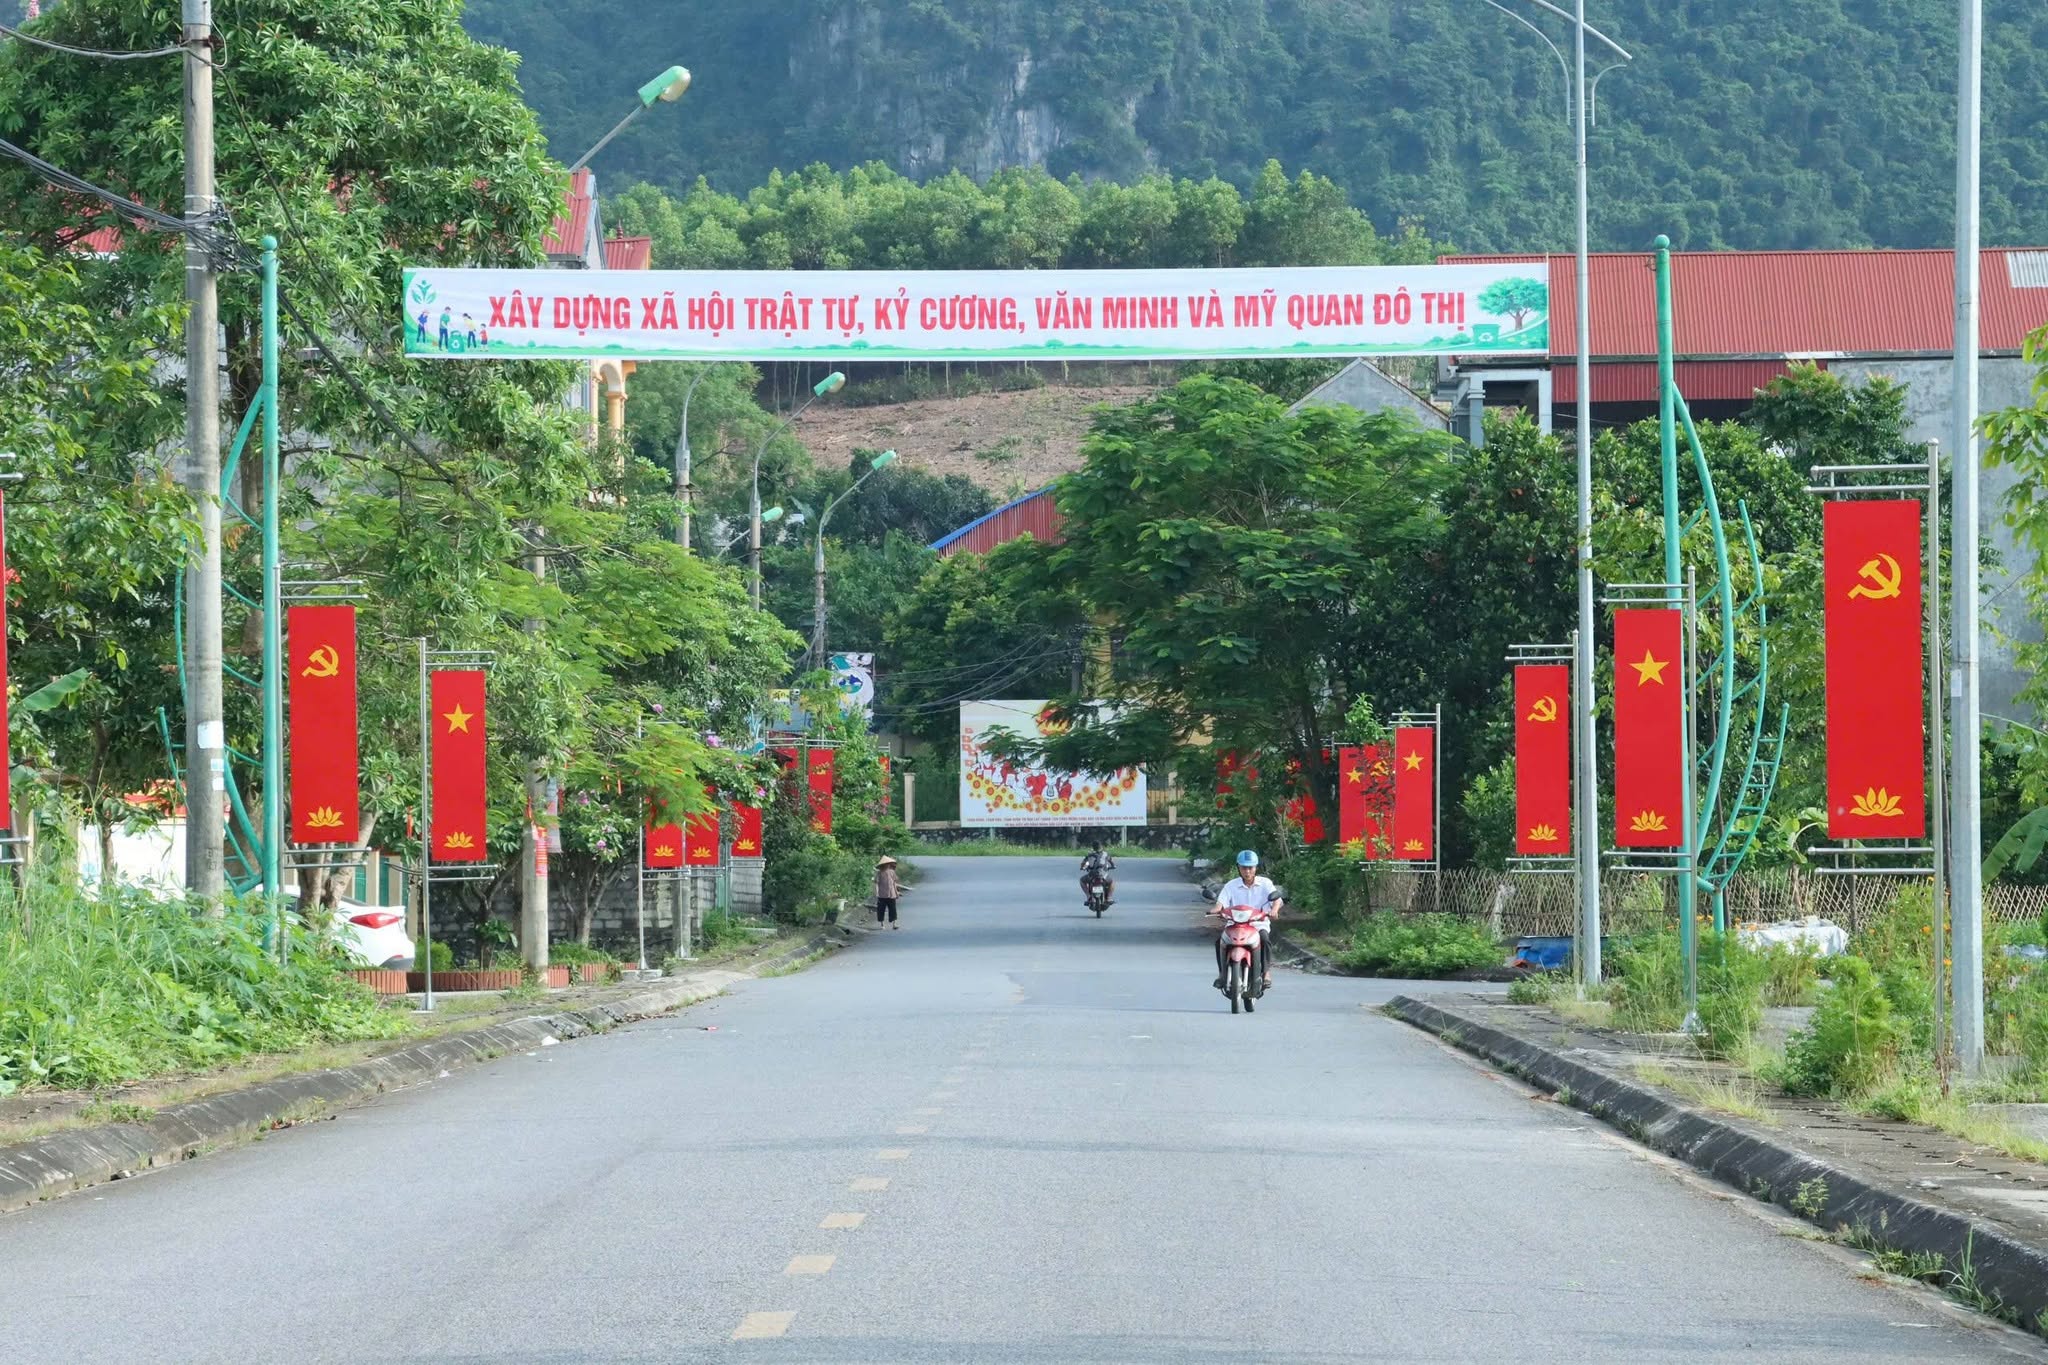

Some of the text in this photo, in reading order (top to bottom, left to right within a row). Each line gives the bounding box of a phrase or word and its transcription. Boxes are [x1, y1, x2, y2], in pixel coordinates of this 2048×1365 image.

[490, 286, 1465, 340] XÂY DỰNG XÃ HỘI TRẬT TỰ, KỶ CƯƠNG, VĂN MINH VÀ MỸ QUAN ĐÔ THỊ
